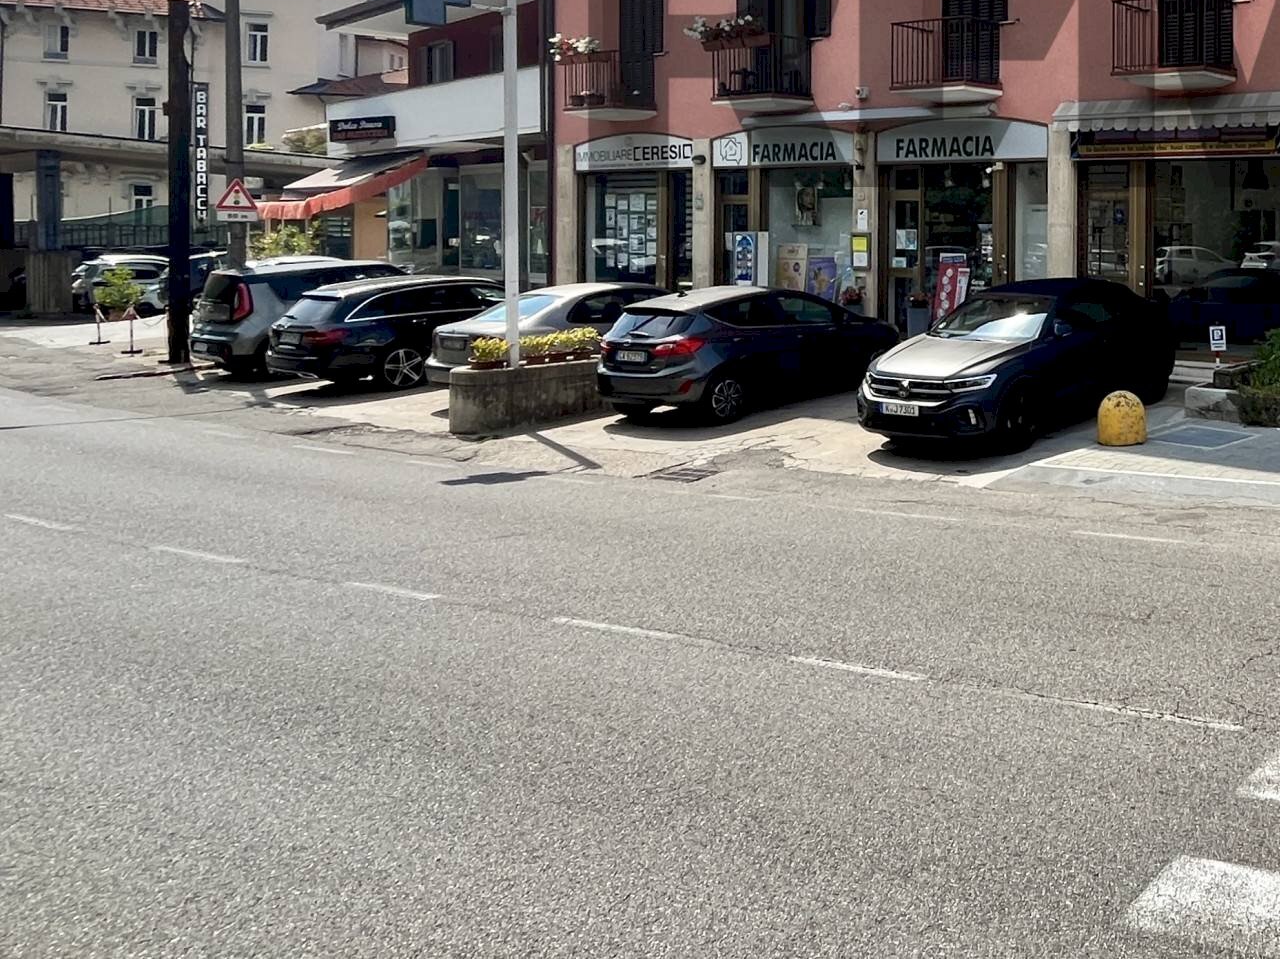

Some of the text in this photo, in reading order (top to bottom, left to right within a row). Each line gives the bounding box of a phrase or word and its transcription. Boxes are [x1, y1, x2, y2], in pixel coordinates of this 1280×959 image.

[196, 91, 207, 129] BAR
[752, 141, 837, 162] FARMACIA
[896, 136, 995, 158] FARMACIA
